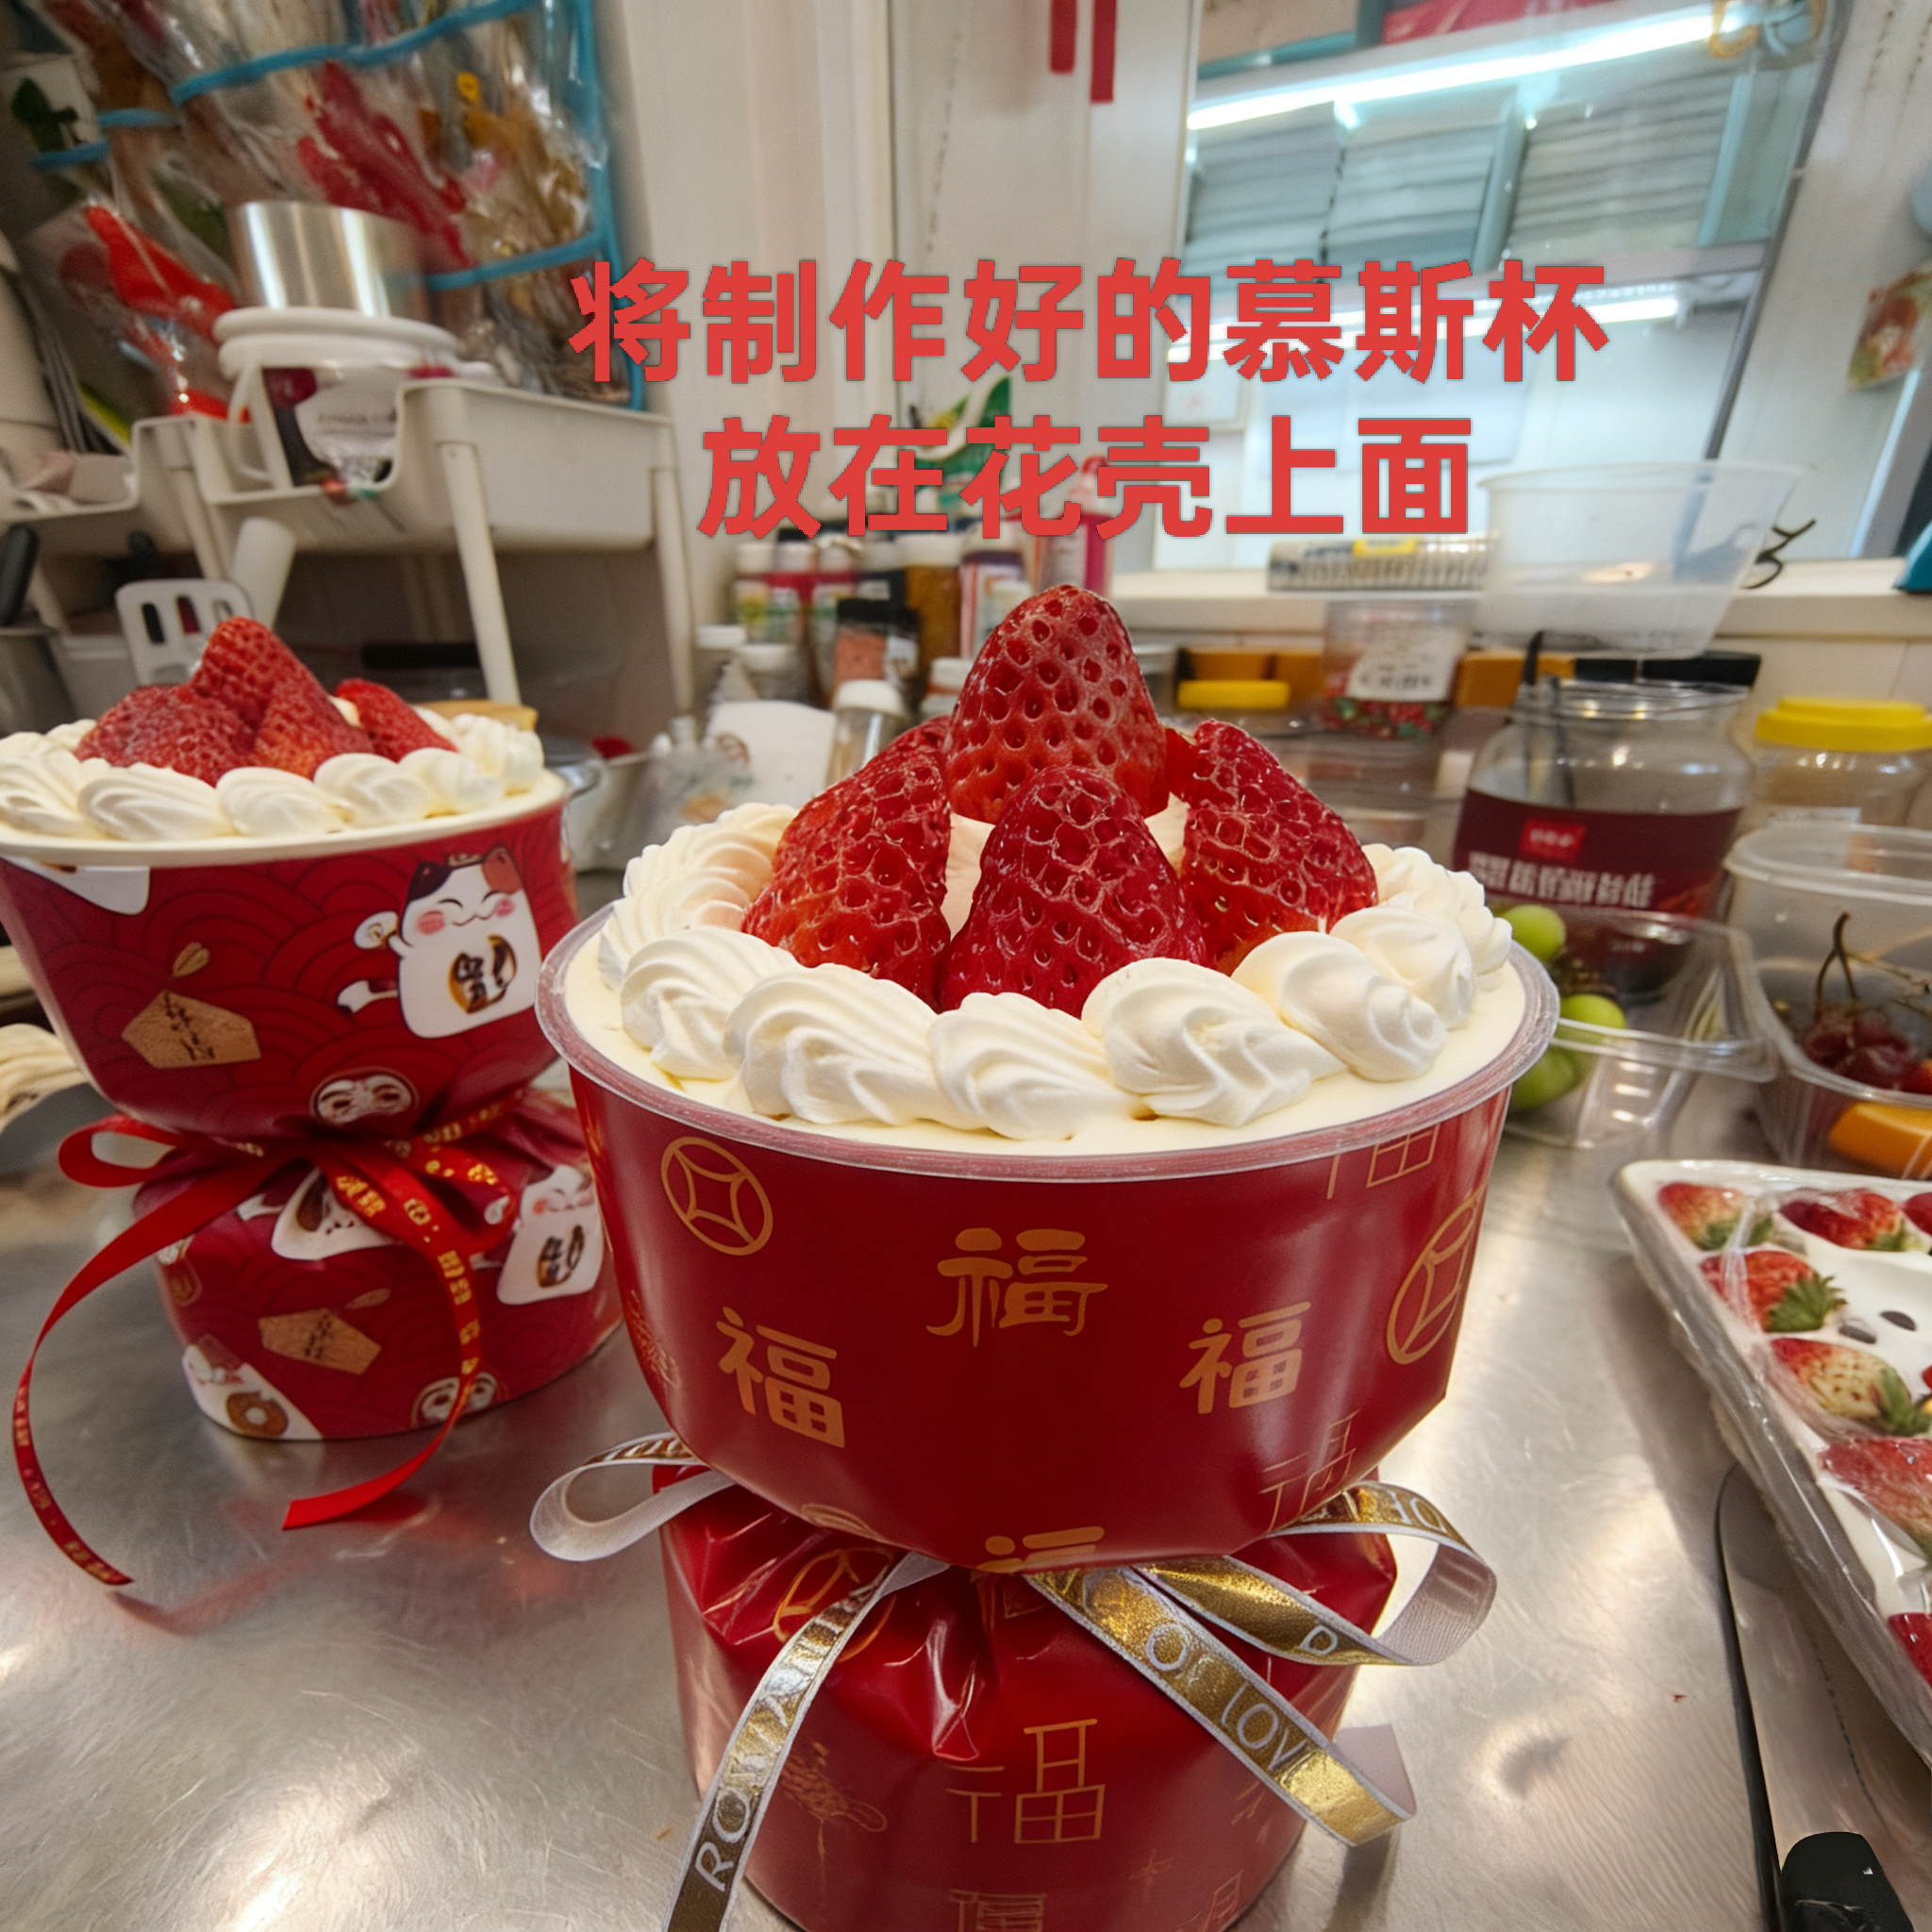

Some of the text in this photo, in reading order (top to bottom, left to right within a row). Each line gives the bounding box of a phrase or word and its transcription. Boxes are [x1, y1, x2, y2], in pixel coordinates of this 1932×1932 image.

[925, 1226, 1108, 1348] 福
[715, 1306, 846, 1449] 福
[1178, 1301, 1311, 1415] 福
